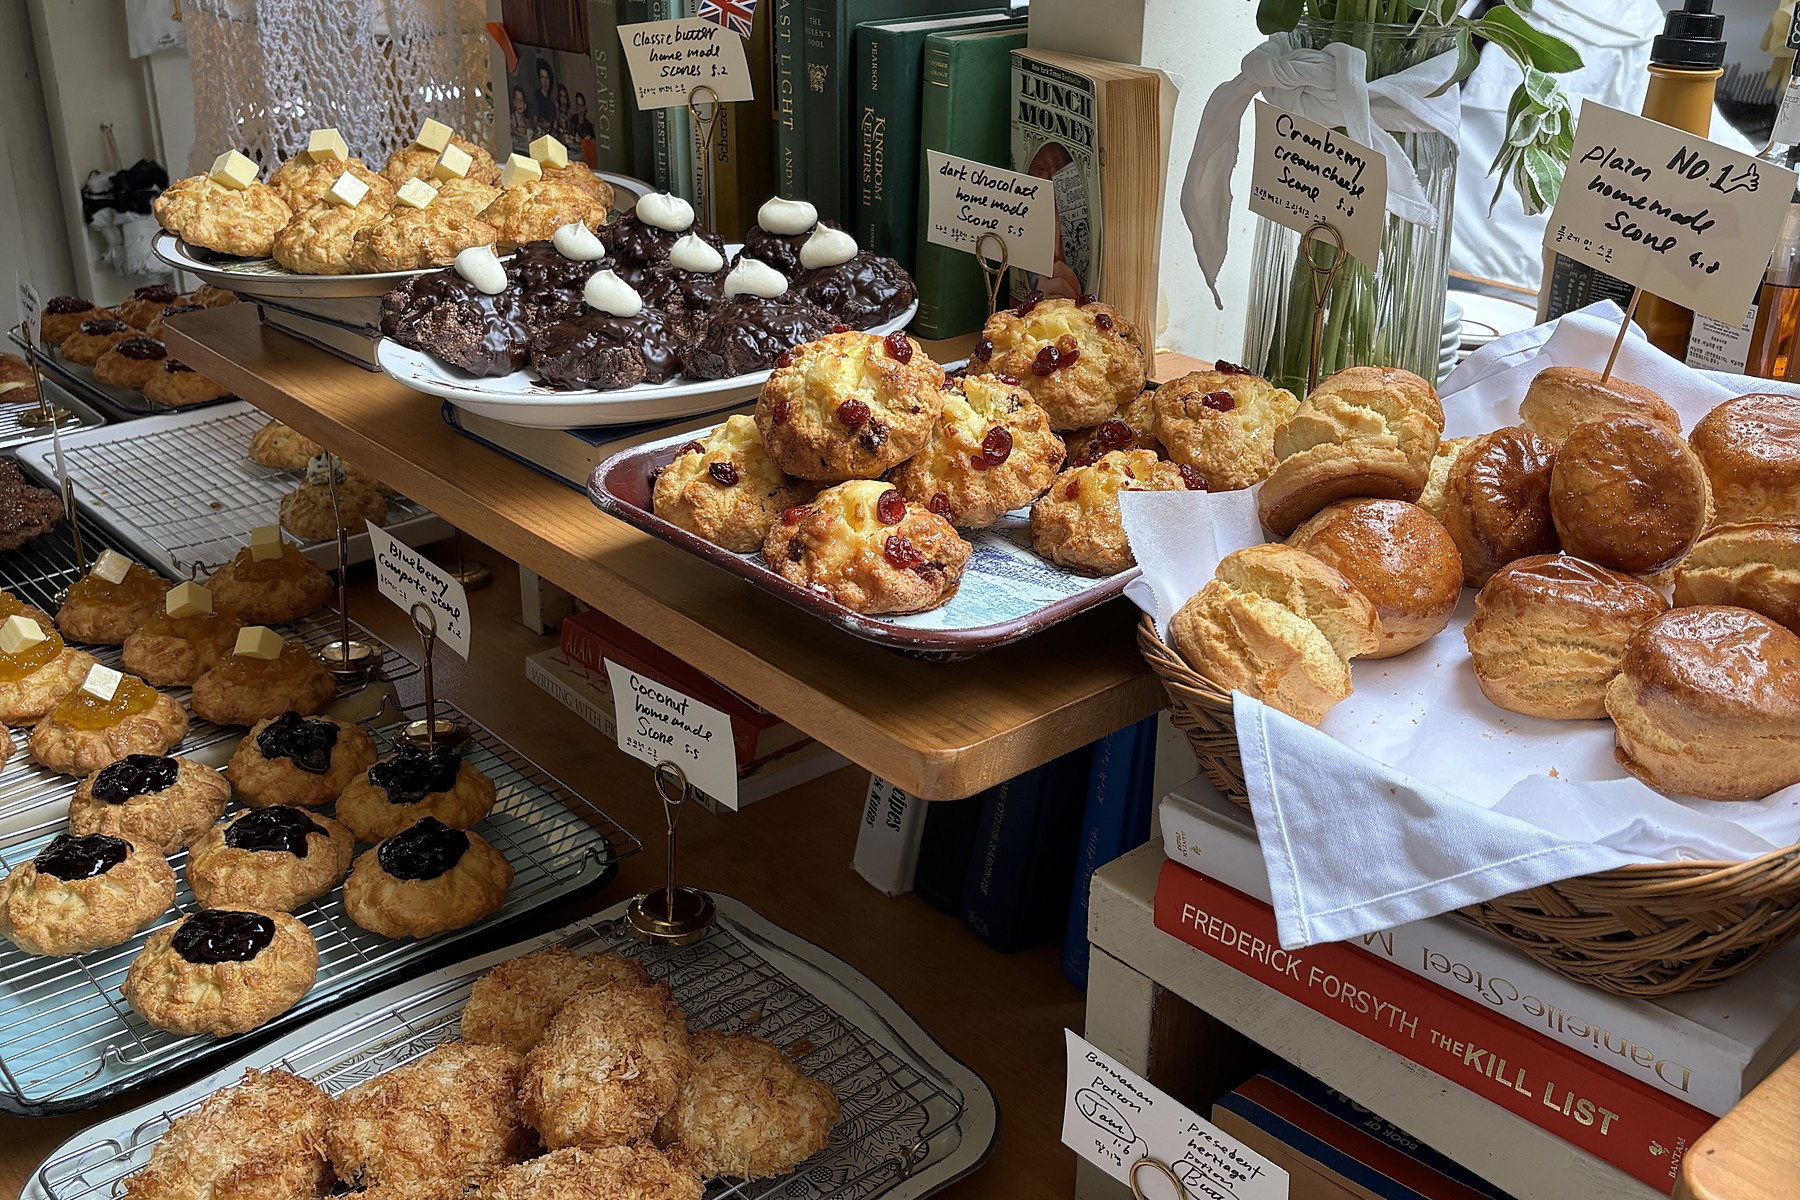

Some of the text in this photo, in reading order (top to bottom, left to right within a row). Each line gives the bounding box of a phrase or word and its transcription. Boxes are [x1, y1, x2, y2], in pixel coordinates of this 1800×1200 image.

[633, 25, 718, 47] Classic butter
[780, 53, 794, 130] LIGHT
[871, 41, 879, 91] PEARSON
[594, 50, 610, 151] SEARCH
[1021, 73, 1093, 124] LUNCH
[657, 110, 666, 148] BEST
[718, 105, 729, 164] Scherzer
[861, 106, 875, 184] KEEPERS
[1018, 100, 1095, 152] MONEY
[1276, 114, 1366, 184] Cranberry
[784, 148, 792, 187] ANDY
[872, 117, 886, 202] KINGDOM
[940, 161, 968, 181] dark
[1597, 245, 1614, 263] 스콘
[390, 541, 449, 597] Blueberry
[566, 631, 593, 664] ALAN
[532, 667, 573, 708] WRITING
[576, 698, 600, 728] WITH
[630, 674, 690, 716] Coconut
[1181, 903, 1619, 1136] FREDERICK FORSYTH THE KILL LIST
[1382, 1129, 1419, 1150] BOOK
[1668, 1136, 1686, 1179] BANTAM
